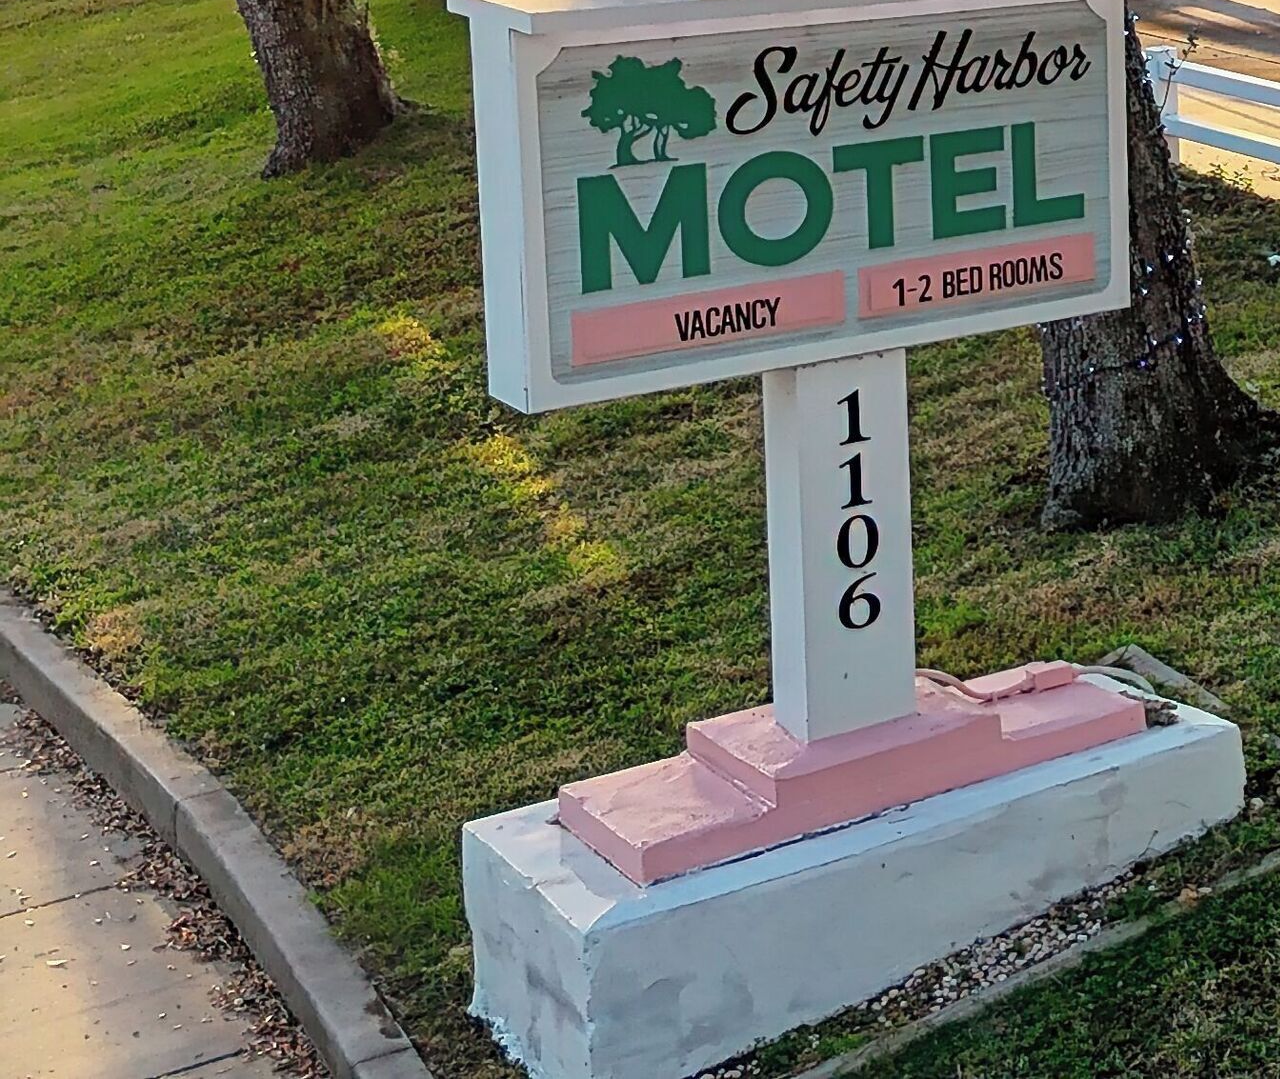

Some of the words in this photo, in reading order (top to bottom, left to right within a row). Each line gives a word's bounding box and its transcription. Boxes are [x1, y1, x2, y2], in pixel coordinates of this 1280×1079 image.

[726, 46, 909, 136] Safety
[906, 28, 1092, 112] Harbor
[576, 121, 1085, 295] MOTEL
[674, 296, 781, 342] VACANCY
[892, 274, 933, 307] 1-2
[942, 266, 983, 299] BED
[989, 252, 1064, 292] ROOMS
[836, 388, 881, 630] 1106
